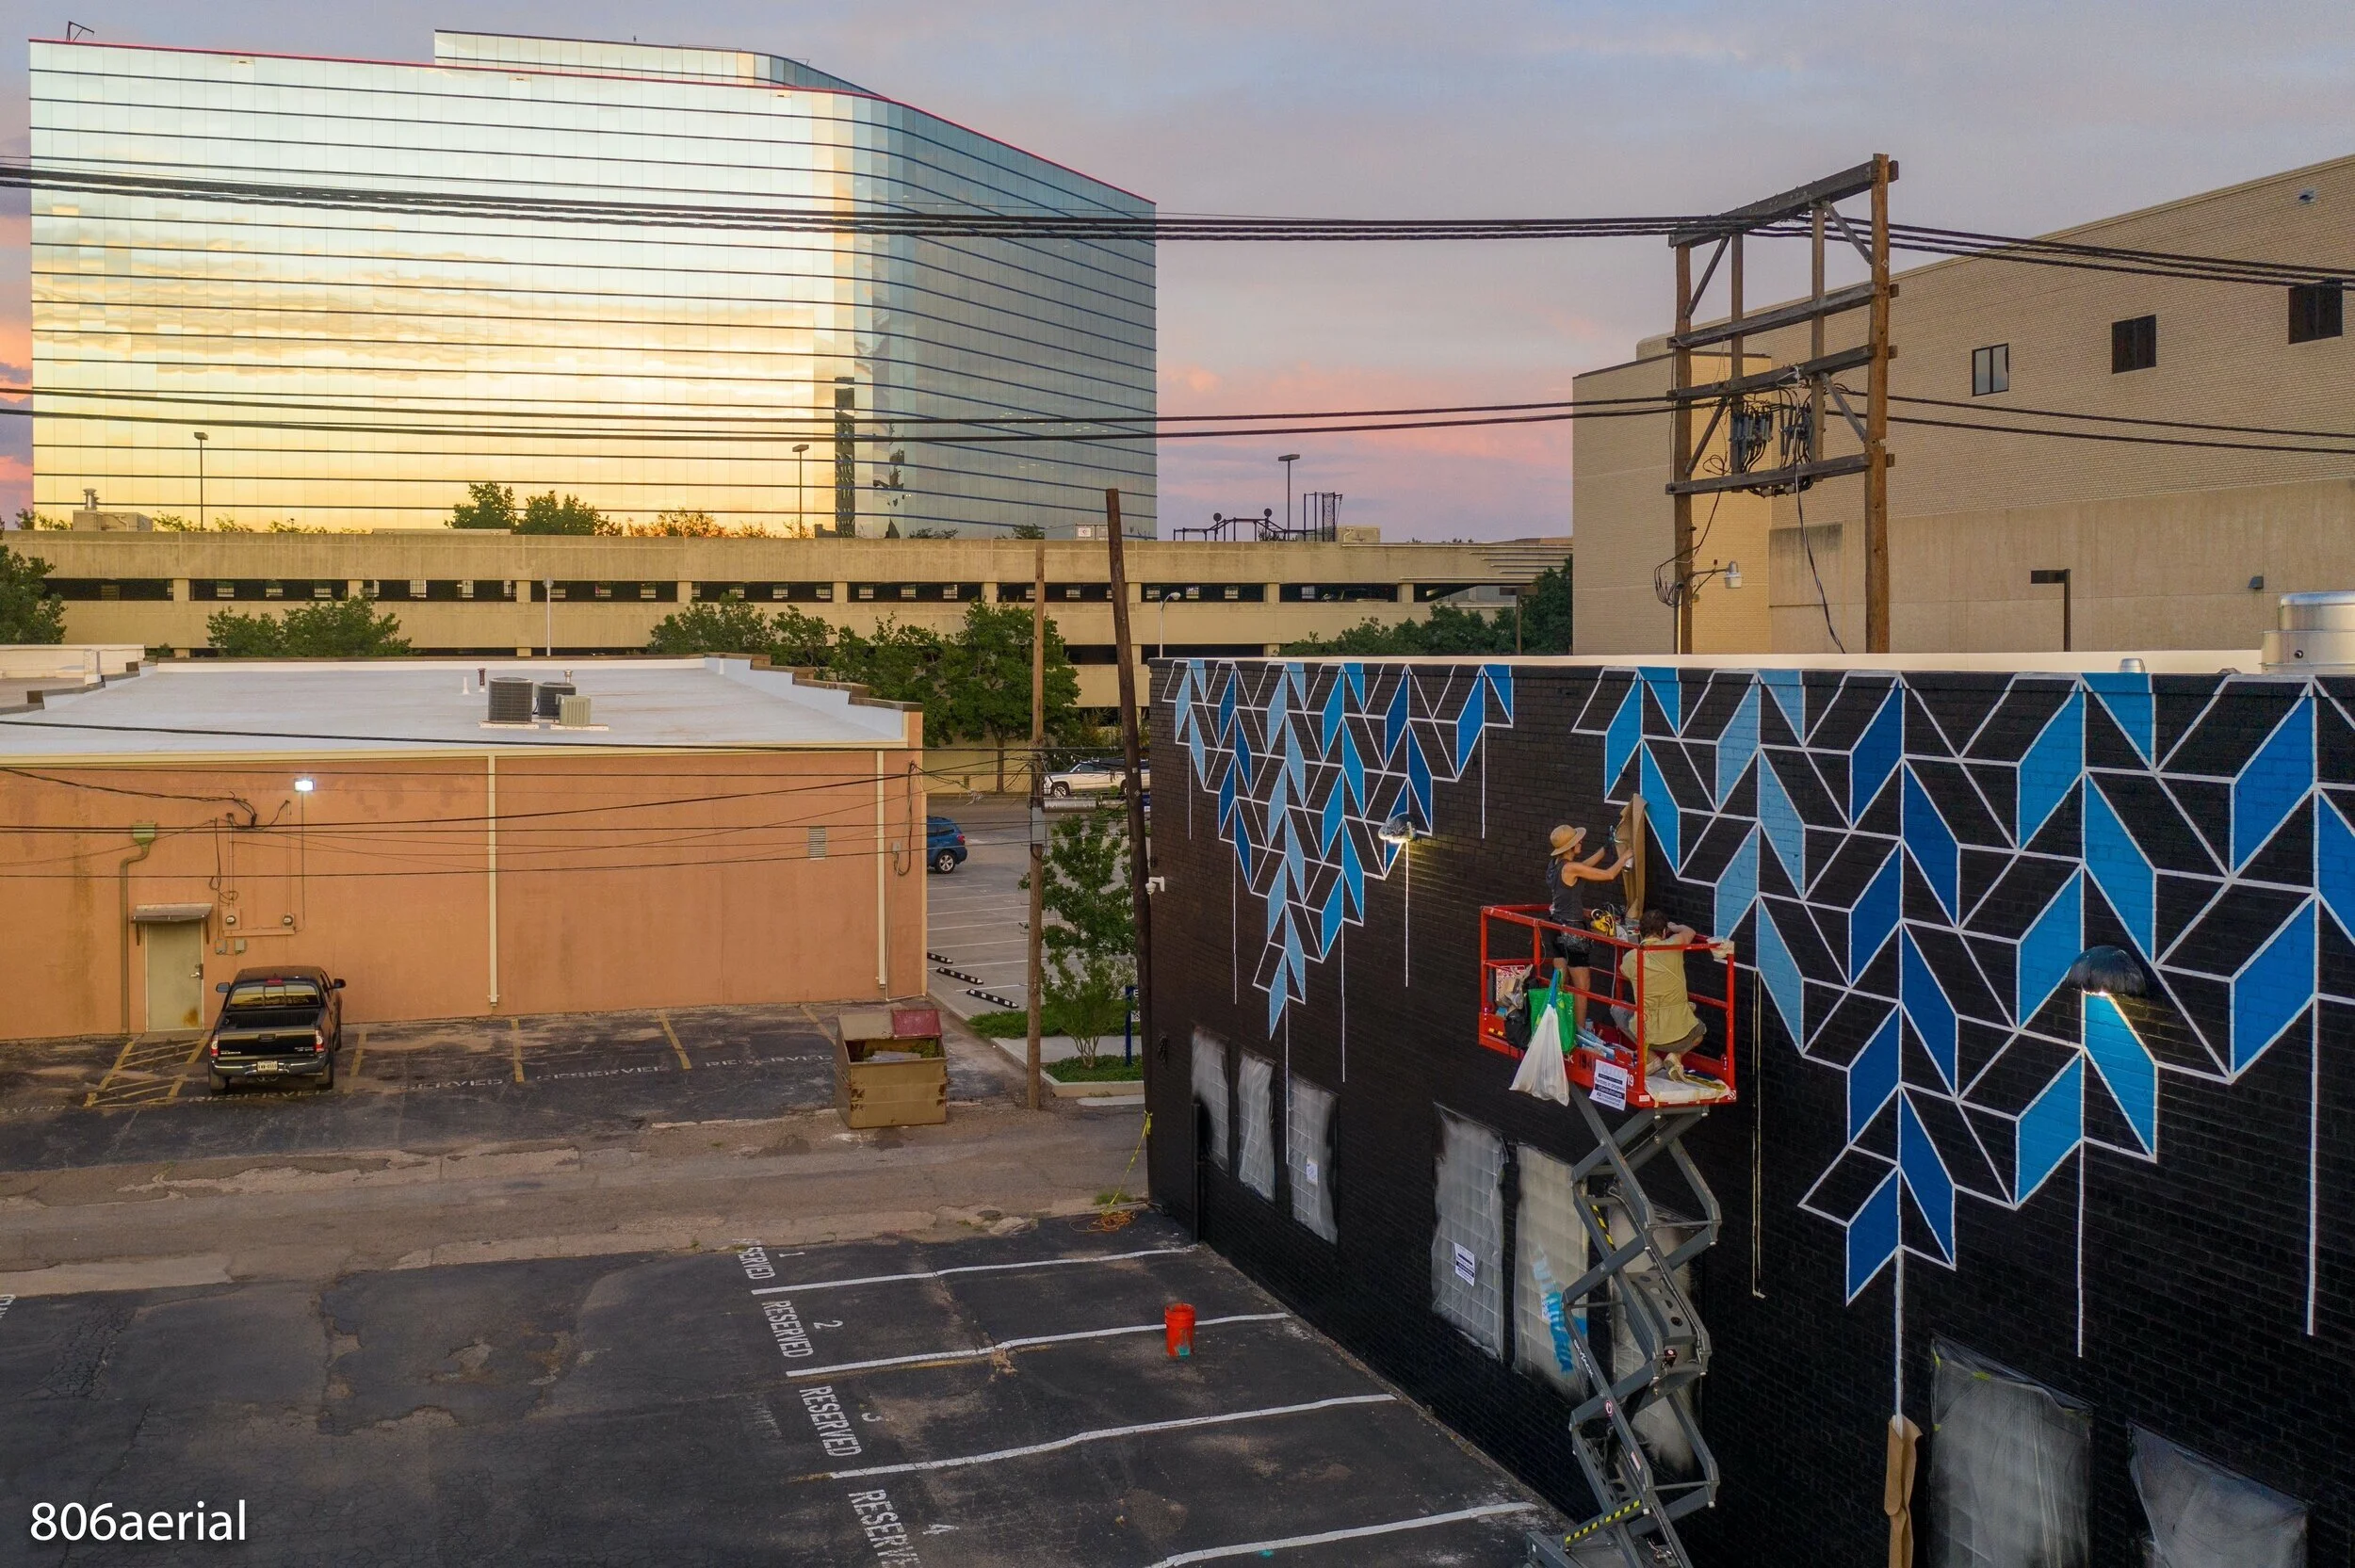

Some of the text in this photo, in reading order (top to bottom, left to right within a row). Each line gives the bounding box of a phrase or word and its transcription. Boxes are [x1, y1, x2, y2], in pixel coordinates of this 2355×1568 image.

[761, 1301, 814, 1358] RESERVED
[813, 1319, 844, 1330] 2
[799, 1385, 863, 1457] RESERVED
